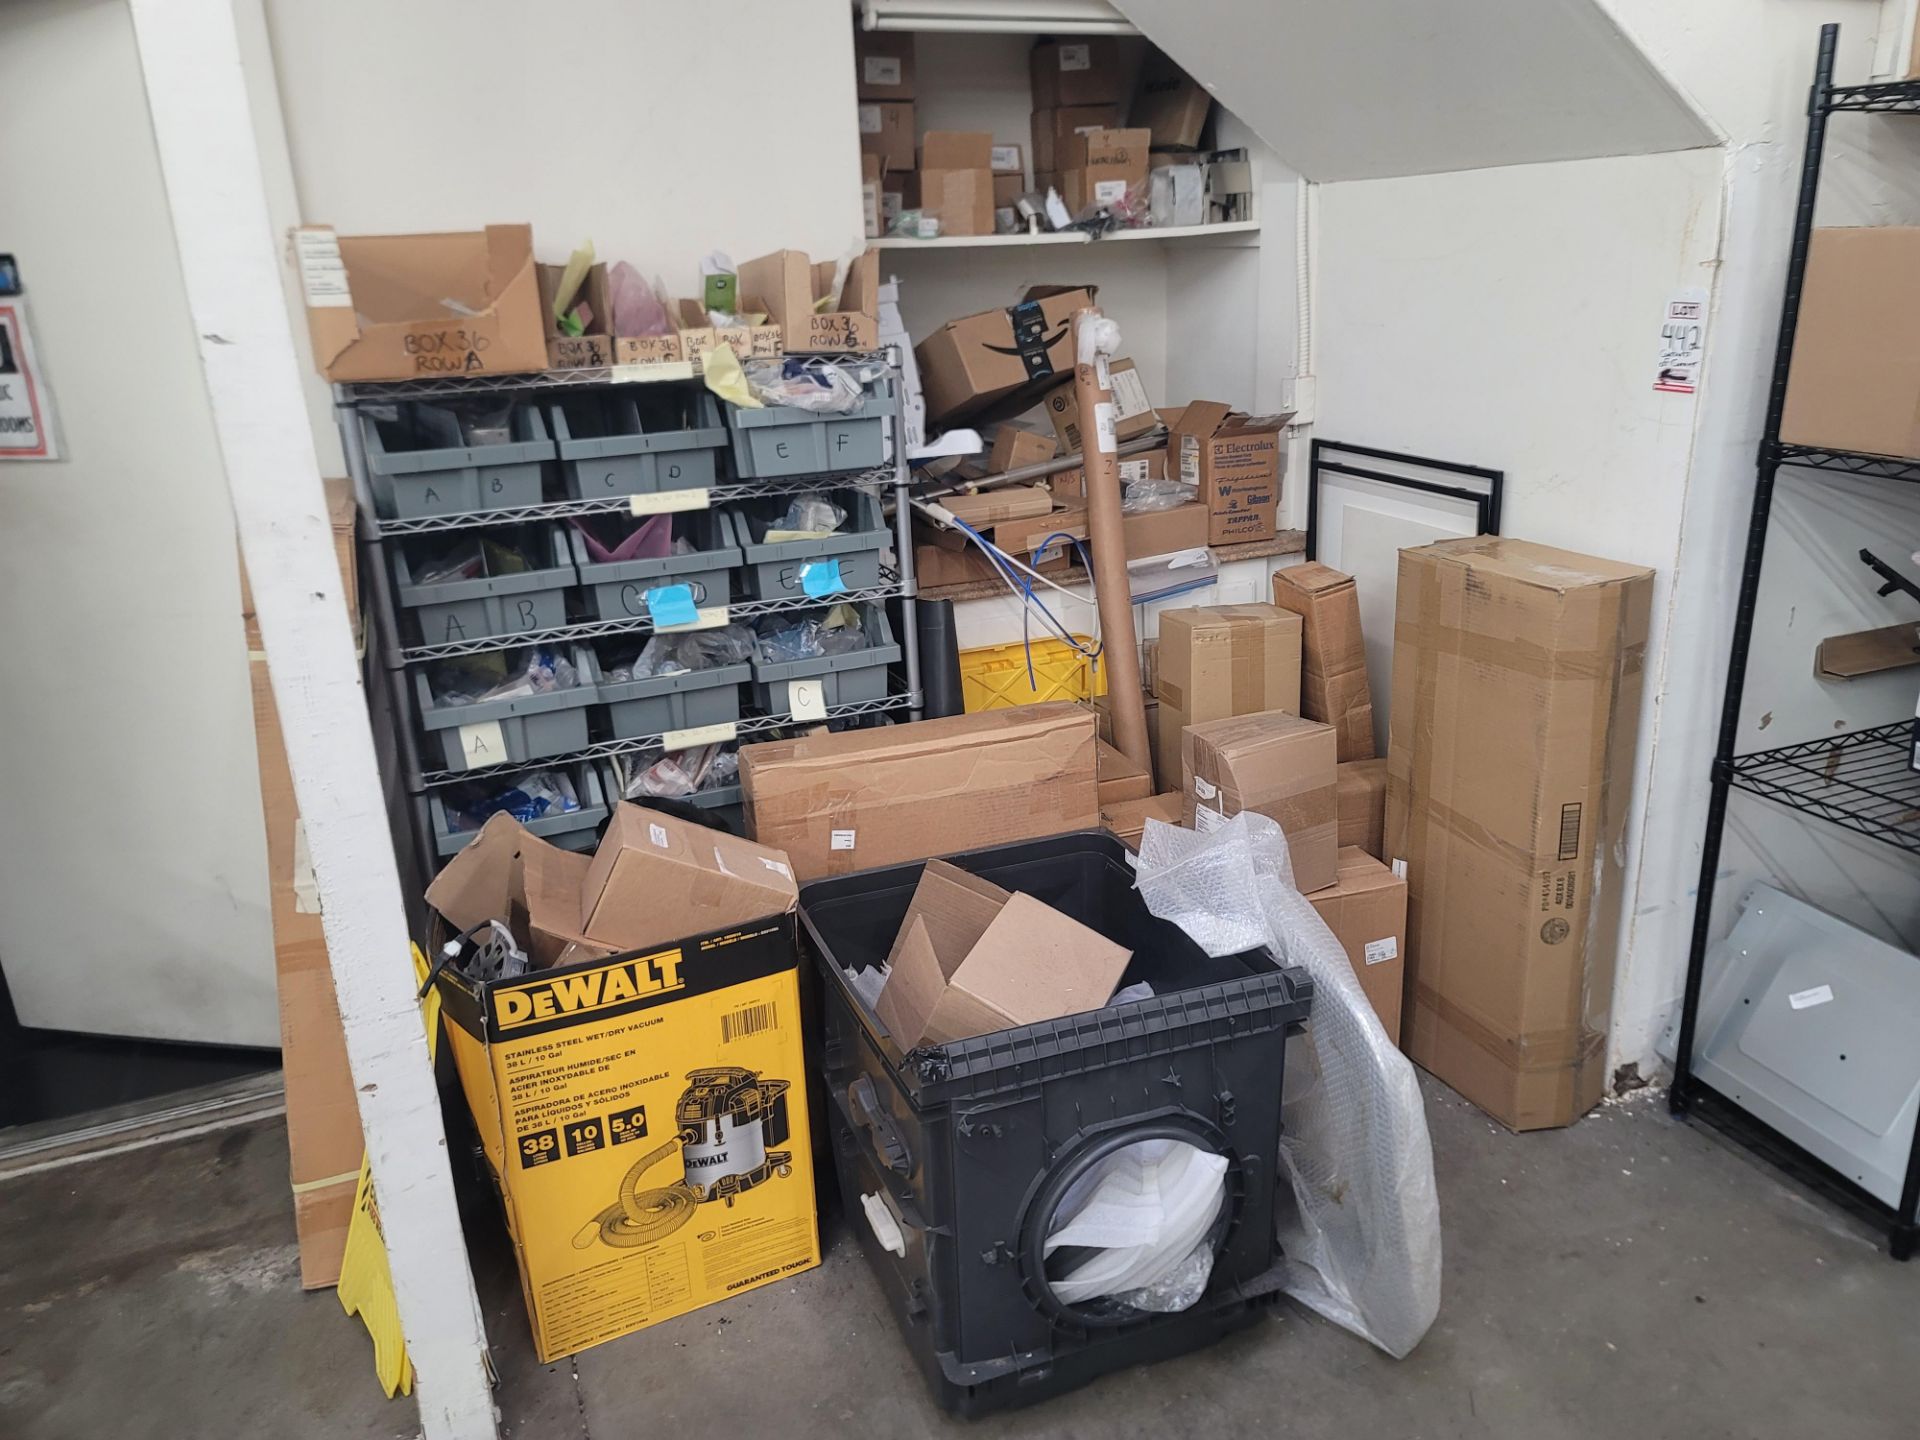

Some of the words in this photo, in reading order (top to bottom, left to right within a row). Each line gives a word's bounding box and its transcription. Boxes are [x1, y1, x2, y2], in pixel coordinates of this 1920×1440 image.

[1671, 304, 1699, 316] LOT
[811, 317, 839, 331] BOX
[841, 316, 859, 332] 36
[404, 331, 454, 354] BOX
[457, 331, 490, 351] 36
[628, 339, 658, 351] BOX
[660, 339, 678, 351] 36
[686, 336, 707, 348] BOX
[722, 334, 743, 345] BOX
[810, 334, 840, 347] ROW
[1661, 323, 1701, 350] 442
[558, 342, 584, 355] BOX
[774, 341, 783, 356] F
[414, 355, 463, 372] ROW
[464, 350, 484, 372] A
[776, 442, 790, 459] E
[836, 434, 849, 452] F
[1226, 441, 1274, 454] Electrolux
[604, 473, 615, 487] C
[668, 465, 681, 479] D
[425, 487, 441, 503] A
[491, 478, 504, 493] B
[1222, 526, 1254, 535] PHILCO
[776, 567, 796, 590] E
[621, 584, 642, 616] C
[446, 614, 466, 642] A
[517, 600, 537, 632] B
[797, 686, 811, 707] C
[474, 735, 489, 753] A
[493, 951, 684, 1026] DEWALT
[505, 1044, 553, 1060] STAINLESS
[556, 1037, 584, 1049] STEEL
[586, 1027, 626, 1041] WET/DRY
[628, 1017, 664, 1031] VACUUM
[507, 1061, 518, 1069] 38
[535, 1054, 546, 1062] 10
[548, 1051, 562, 1059] Gal
[509, 1065, 565, 1085] ASPIRATEUR
[567, 1053, 622, 1071] HUMIDE/SEC
[624, 1049, 636, 1057] EN
[511, 1082, 538, 1093] ACIER
[540, 1068, 596, 1086] INOXYDABLE
[598, 1064, 610, 1073] DE
[553, 1083, 568, 1091] Gal
[514, 1098, 571, 1117] ASPIRADORA
[573, 1094, 586, 1102] DE
[588, 1086, 618, 1098] ACERO
[619, 1071, 670, 1091] INOXIDABLE
[515, 1114, 539, 1125] PARA
[542, 1103, 583, 1118] LÍQUIDOS
[593, 1091, 631, 1106] SÓLIDOS
[517, 1125, 529, 1133] DE
[573, 1111, 587, 1119] Gal
[612, 1112, 645, 1133] 5.0
[571, 1125, 598, 1142] 10
[523, 1134, 554, 1155] 38
[686, 1151, 728, 1168] DEWALT
[726, 1268, 781, 1291] GUARANTEED
